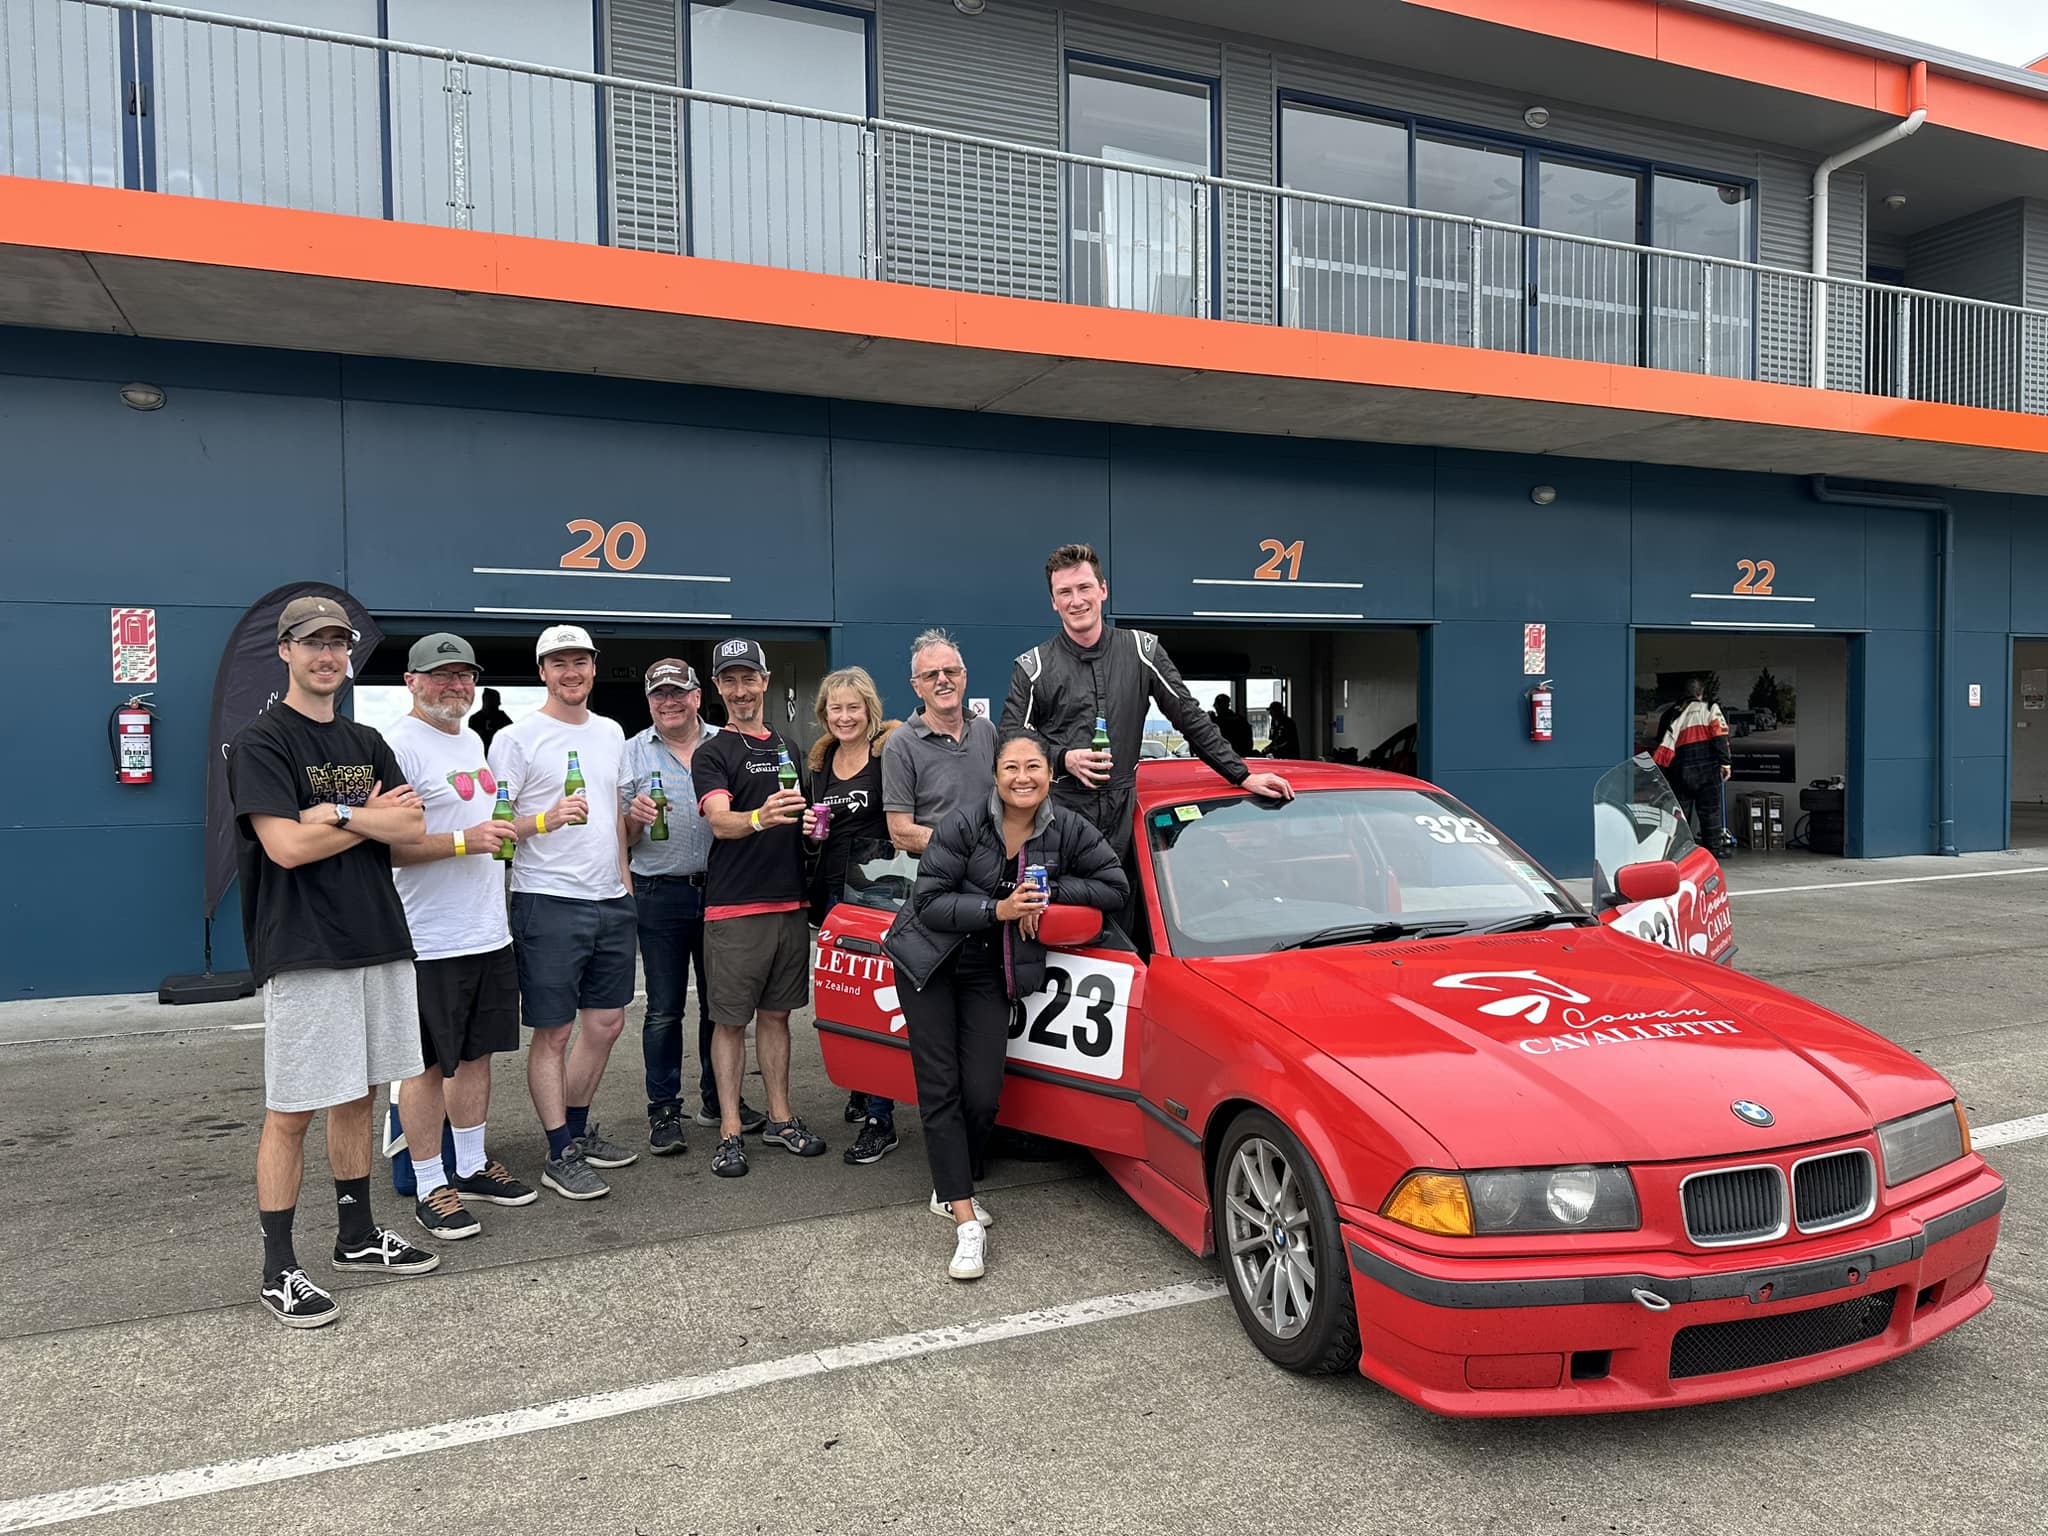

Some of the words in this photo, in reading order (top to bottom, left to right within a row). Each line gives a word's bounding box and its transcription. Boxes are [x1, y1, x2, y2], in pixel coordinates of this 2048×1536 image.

[560, 518, 646, 571] 20
[1254, 539, 1304, 580] 21
[1733, 559, 1775, 595] 22
[1415, 815, 1500, 845] 323
[825, 979, 860, 996] Zealand
[1563, 1008, 1708, 1029] Cowan
